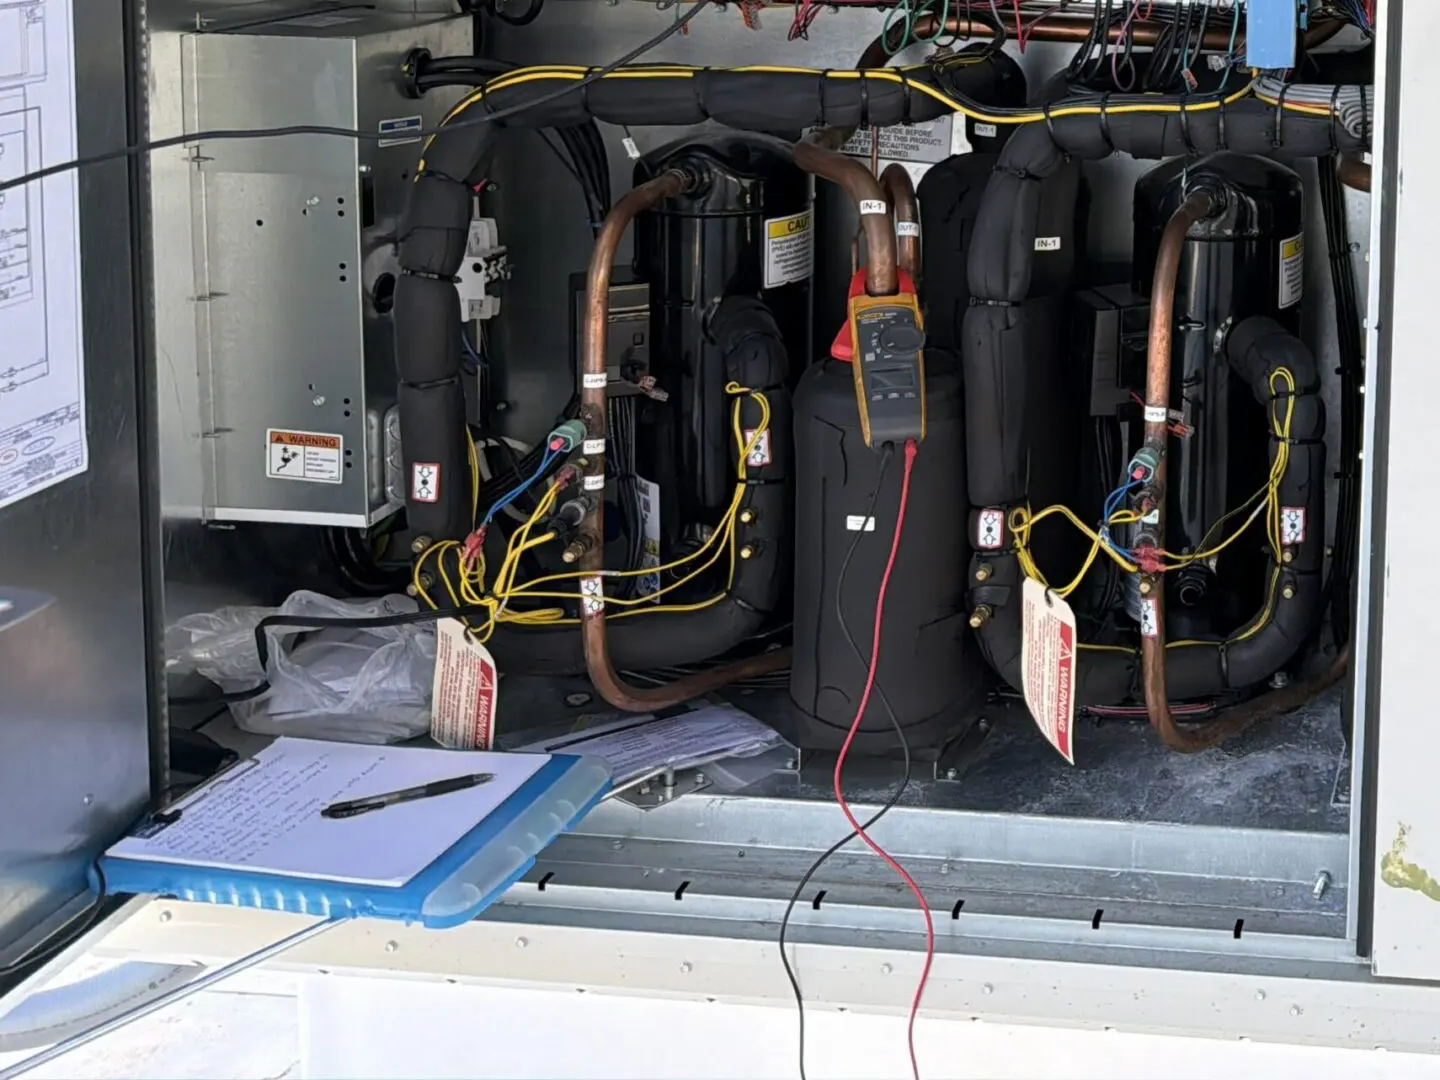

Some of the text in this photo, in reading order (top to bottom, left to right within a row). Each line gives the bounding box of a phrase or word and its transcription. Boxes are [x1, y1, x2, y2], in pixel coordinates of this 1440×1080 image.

[850, 137, 872, 145] AFETY
[863, 132, 892, 142] SEVICE
[863, 202, 882, 211] IN-1
[1038, 239, 1057, 248] IN-1
[289, 434, 336, 447] WARNING
[1058, 668, 1069, 733] WARNING
[476, 695, 489, 750] WARNING
